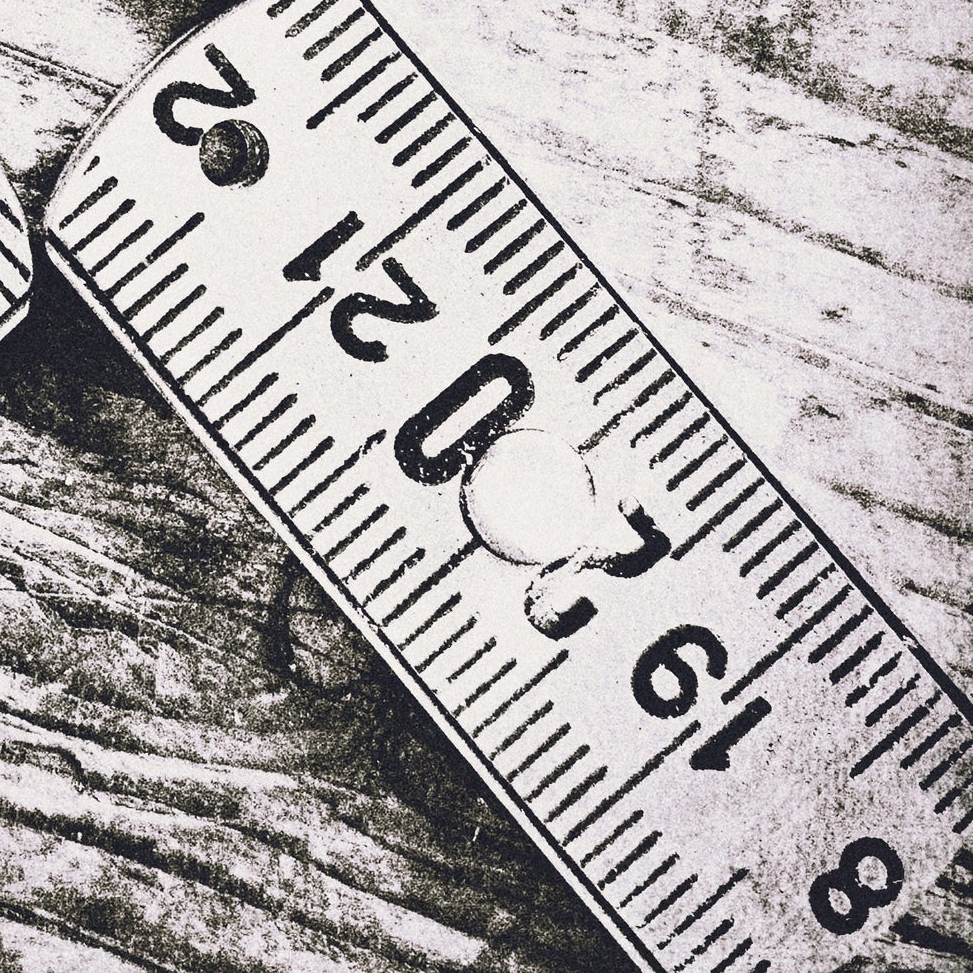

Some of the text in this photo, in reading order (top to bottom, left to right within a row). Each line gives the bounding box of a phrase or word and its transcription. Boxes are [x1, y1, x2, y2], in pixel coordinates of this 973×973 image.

[153, 44, 257, 147] 2
[282, 210, 439, 364] 21
[631, 624, 773, 772] 19
[808, 836, 905, 936] 8
